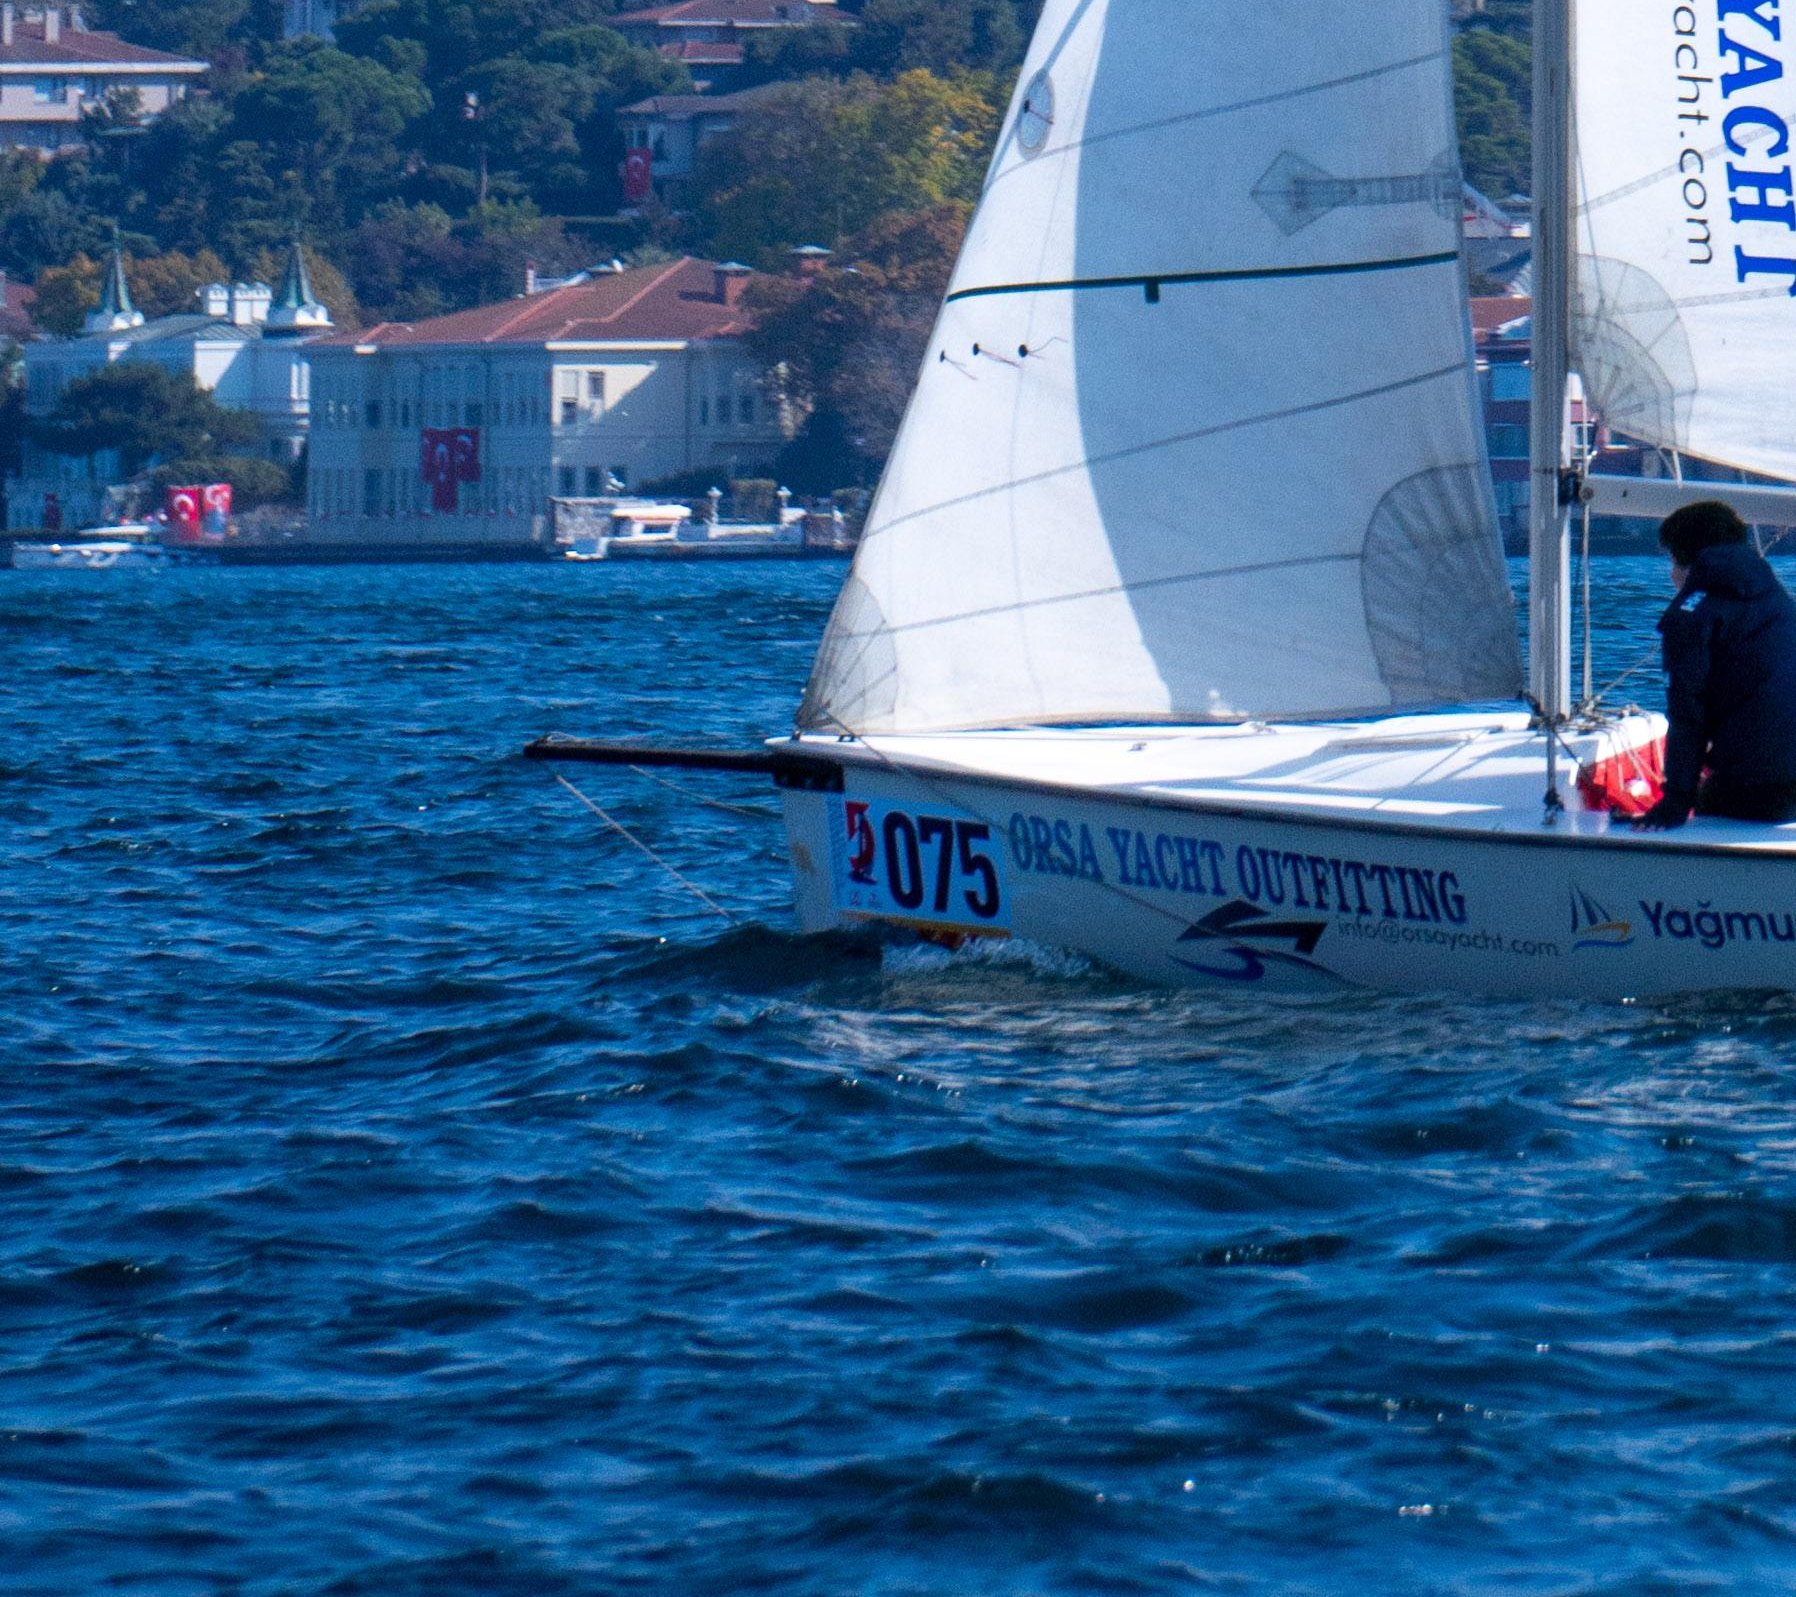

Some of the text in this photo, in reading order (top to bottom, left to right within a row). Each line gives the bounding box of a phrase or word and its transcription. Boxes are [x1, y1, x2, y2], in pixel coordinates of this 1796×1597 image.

[883, 811, 999, 918] 075
[1008, 811, 1467, 924] ORSA YACHT OUTFITTING
